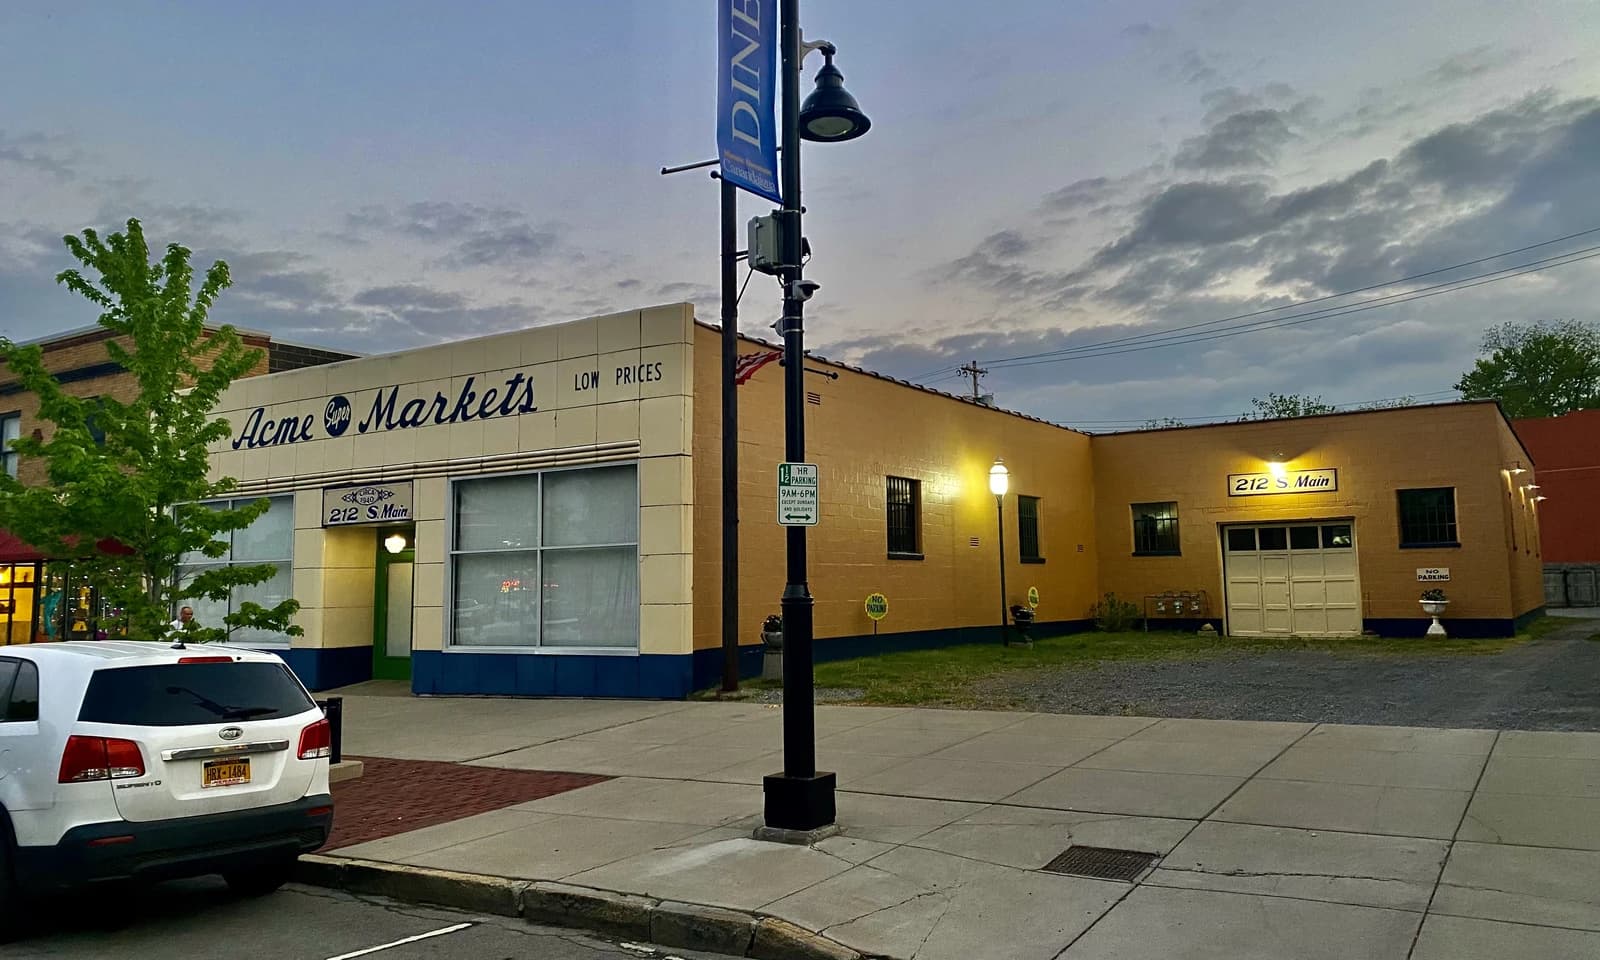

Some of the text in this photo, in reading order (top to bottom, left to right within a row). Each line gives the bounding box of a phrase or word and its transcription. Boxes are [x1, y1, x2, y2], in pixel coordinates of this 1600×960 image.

[574, 362, 662, 391] LOW PRICES
[232, 372, 537, 450] Acme Super Markets
[797, 467, 808, 475] HR
[791, 476, 816, 485] PARKING
[1235, 477, 1268, 491] 212
[1295, 474, 1329, 488] Main
[359, 487, 375, 497] CIRCA
[359, 495, 375, 504] 1940
[328, 503, 408, 523] 212 S. Main
[871, 595, 883, 603] NO
[866, 603, 887, 613] PARKING
